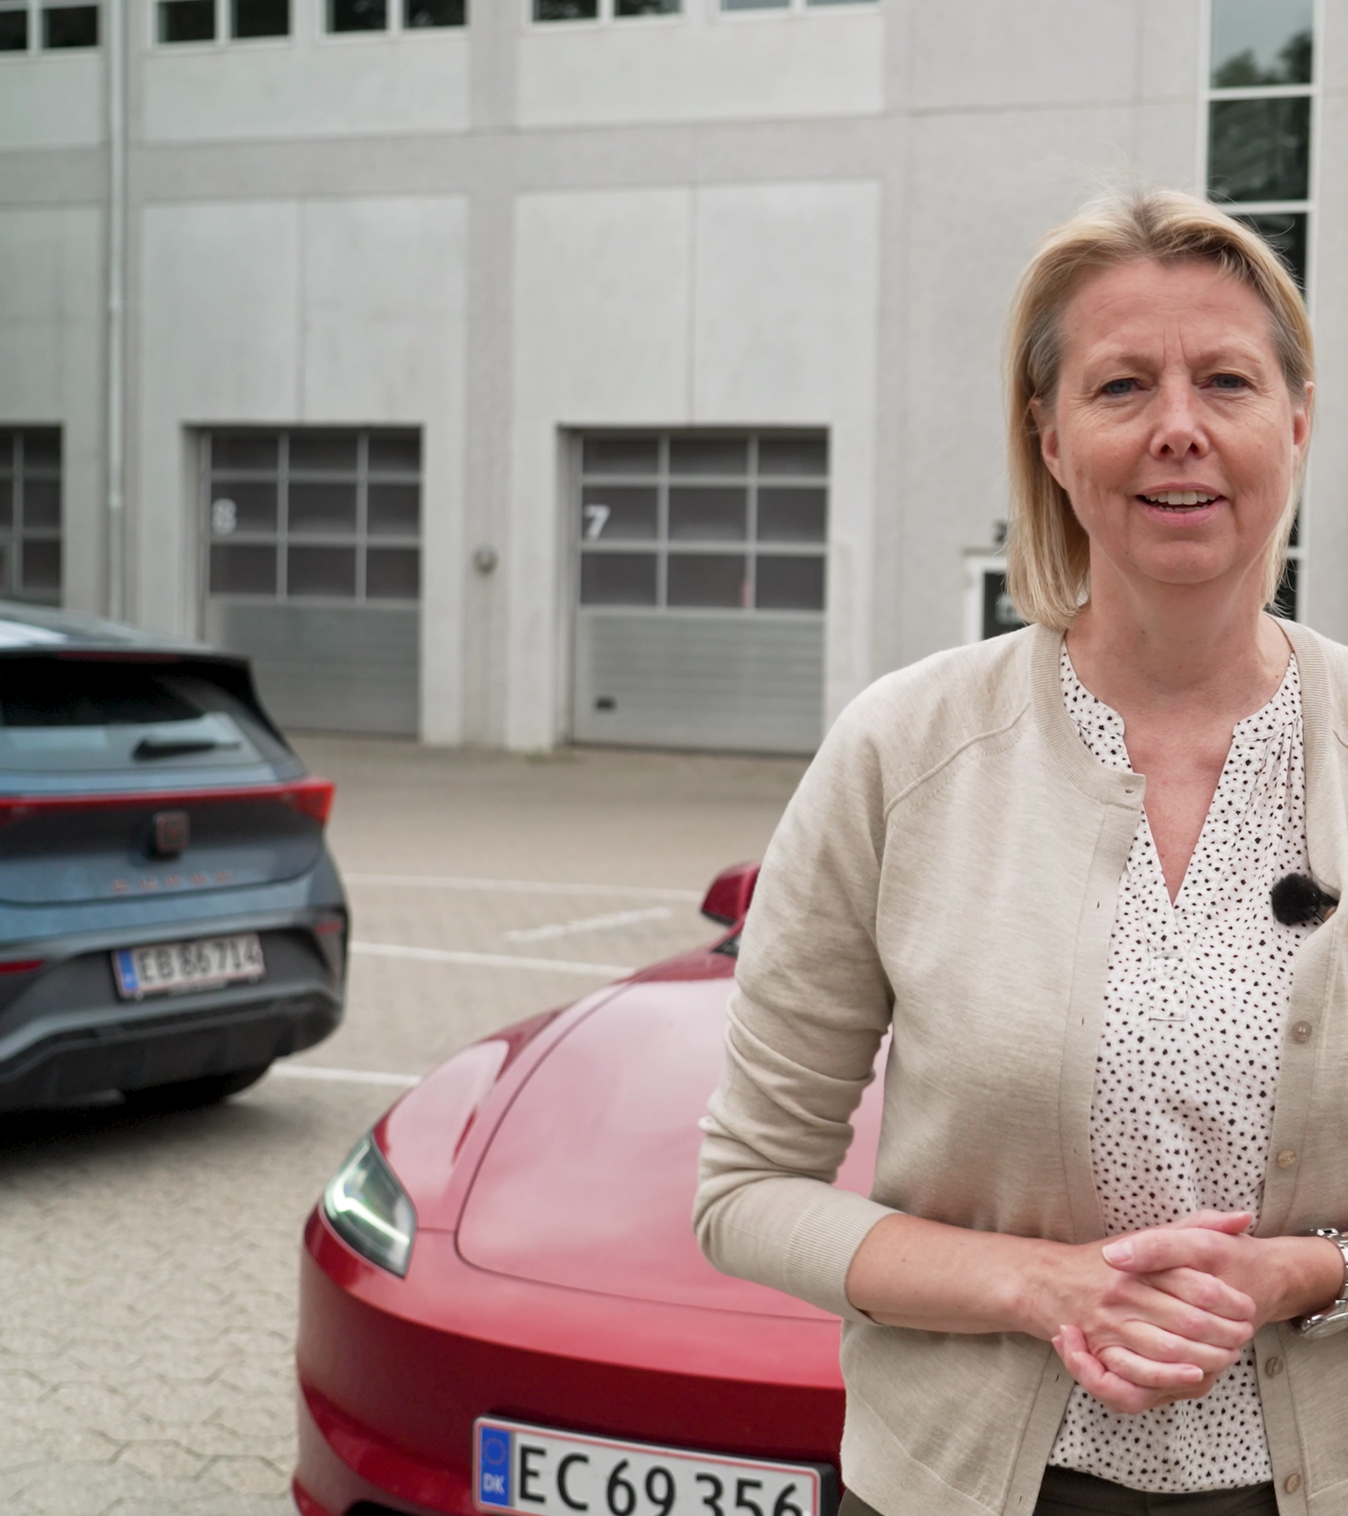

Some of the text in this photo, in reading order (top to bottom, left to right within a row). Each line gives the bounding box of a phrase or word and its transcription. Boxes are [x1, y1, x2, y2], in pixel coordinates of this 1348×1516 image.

[584, 504, 611, 542] 7
[483, 1473, 505, 1495] DK
[519, 1444, 589, 1511] EC
